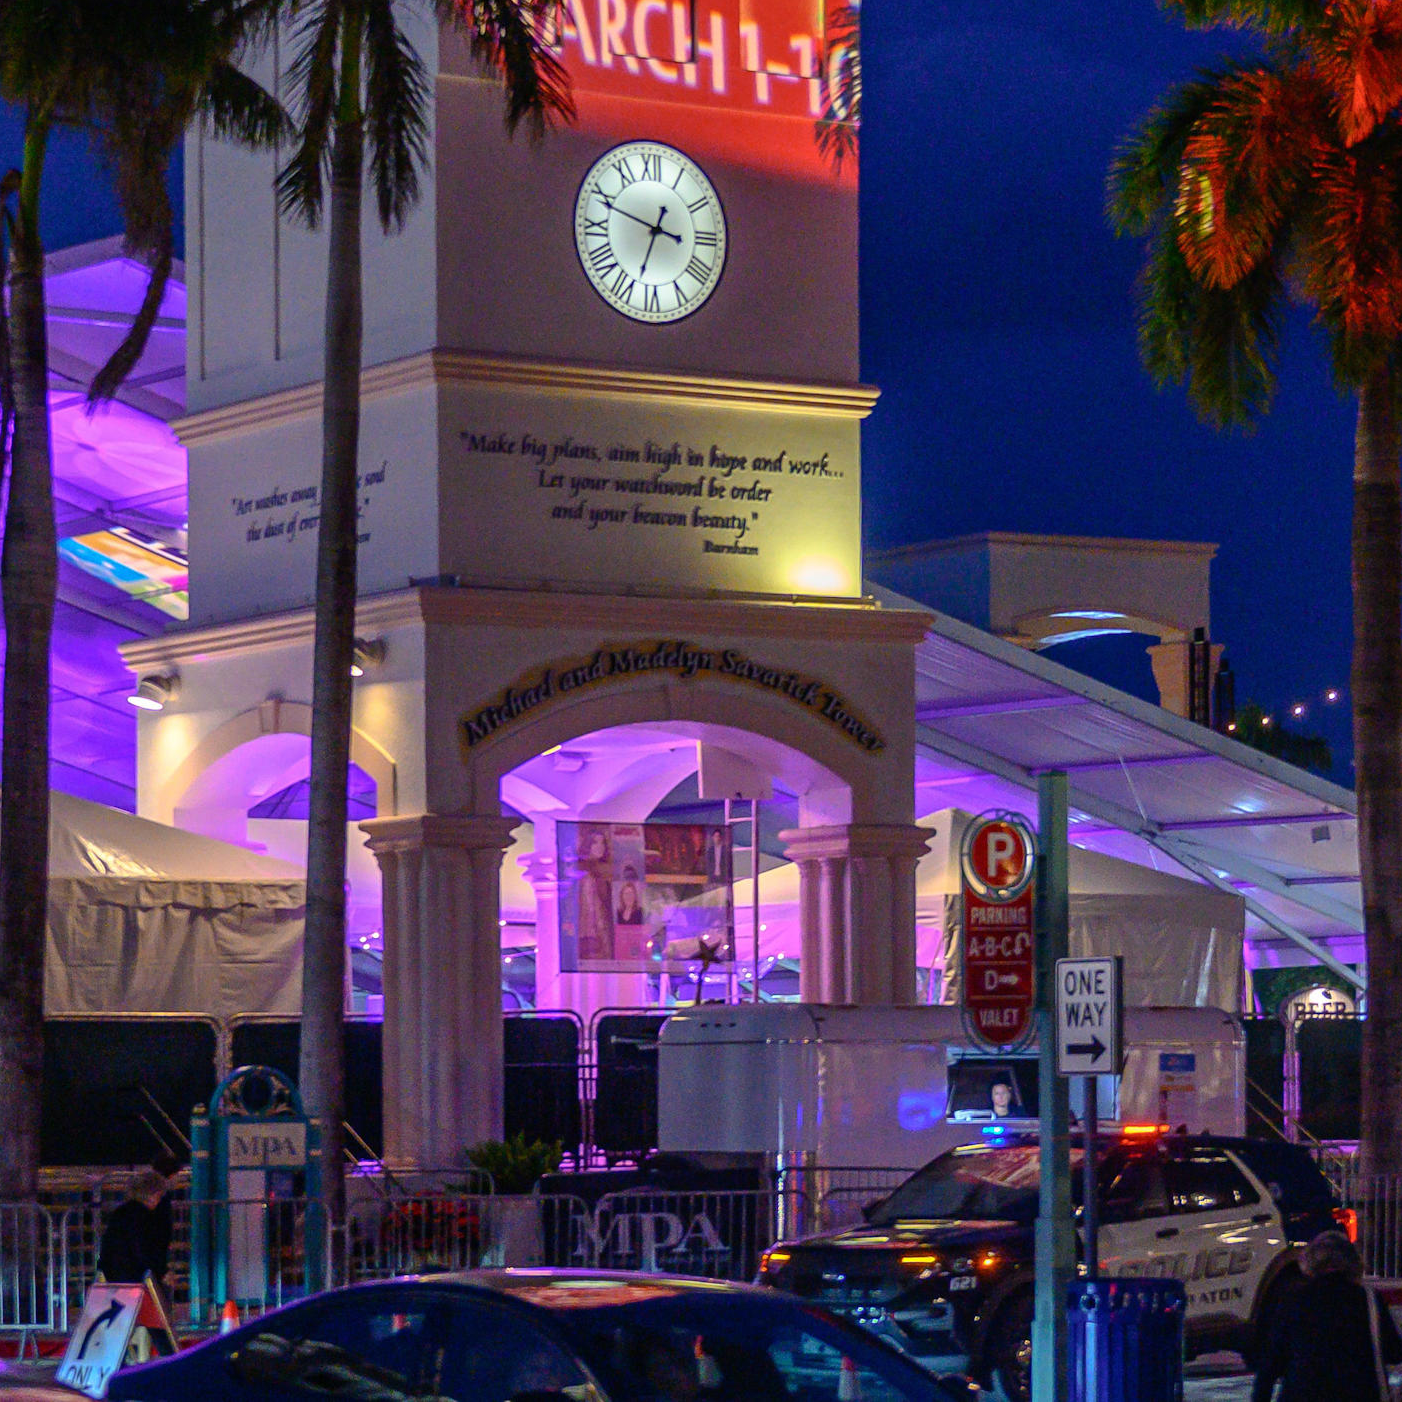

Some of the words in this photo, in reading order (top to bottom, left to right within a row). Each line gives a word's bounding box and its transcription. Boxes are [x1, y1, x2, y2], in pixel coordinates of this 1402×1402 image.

[521, 434, 547, 465] big
[606, 445, 640, 463] aim
[644, 441, 682, 473] high
[687, 447, 704, 467] in
[709, 445, 748, 477] hope
[752, 450, 786, 473] and
[789, 452, 844, 478] work...
[538, 469, 565, 488] Let
[569, 475, 610, 498] your
[707, 476, 727, 499] be
[731, 479, 772, 502] order
[552, 500, 587, 519] and
[587, 508, 628, 530] your
[632, 502, 687, 527] beacon
[462, 669, 556, 746] Michael
[558, 649, 607, 692] and
[608, 640, 715, 679] Madelyn
[719, 649, 825, 706] Savarick
[820, 691, 887, 751] Tower
[986, 831, 1017, 878] P
[970, 906, 1028, 925] PARKING
[984, 970, 998, 991] D
[1064, 969, 1106, 996] ONE
[979, 1008, 1020, 1027] VALET
[1065, 1001, 1107, 1028] WAY
[232, 1135, 299, 1165] MPA
[569, 1211, 732, 1273] MPA
[66, 1364, 111, 1390] ONLY
